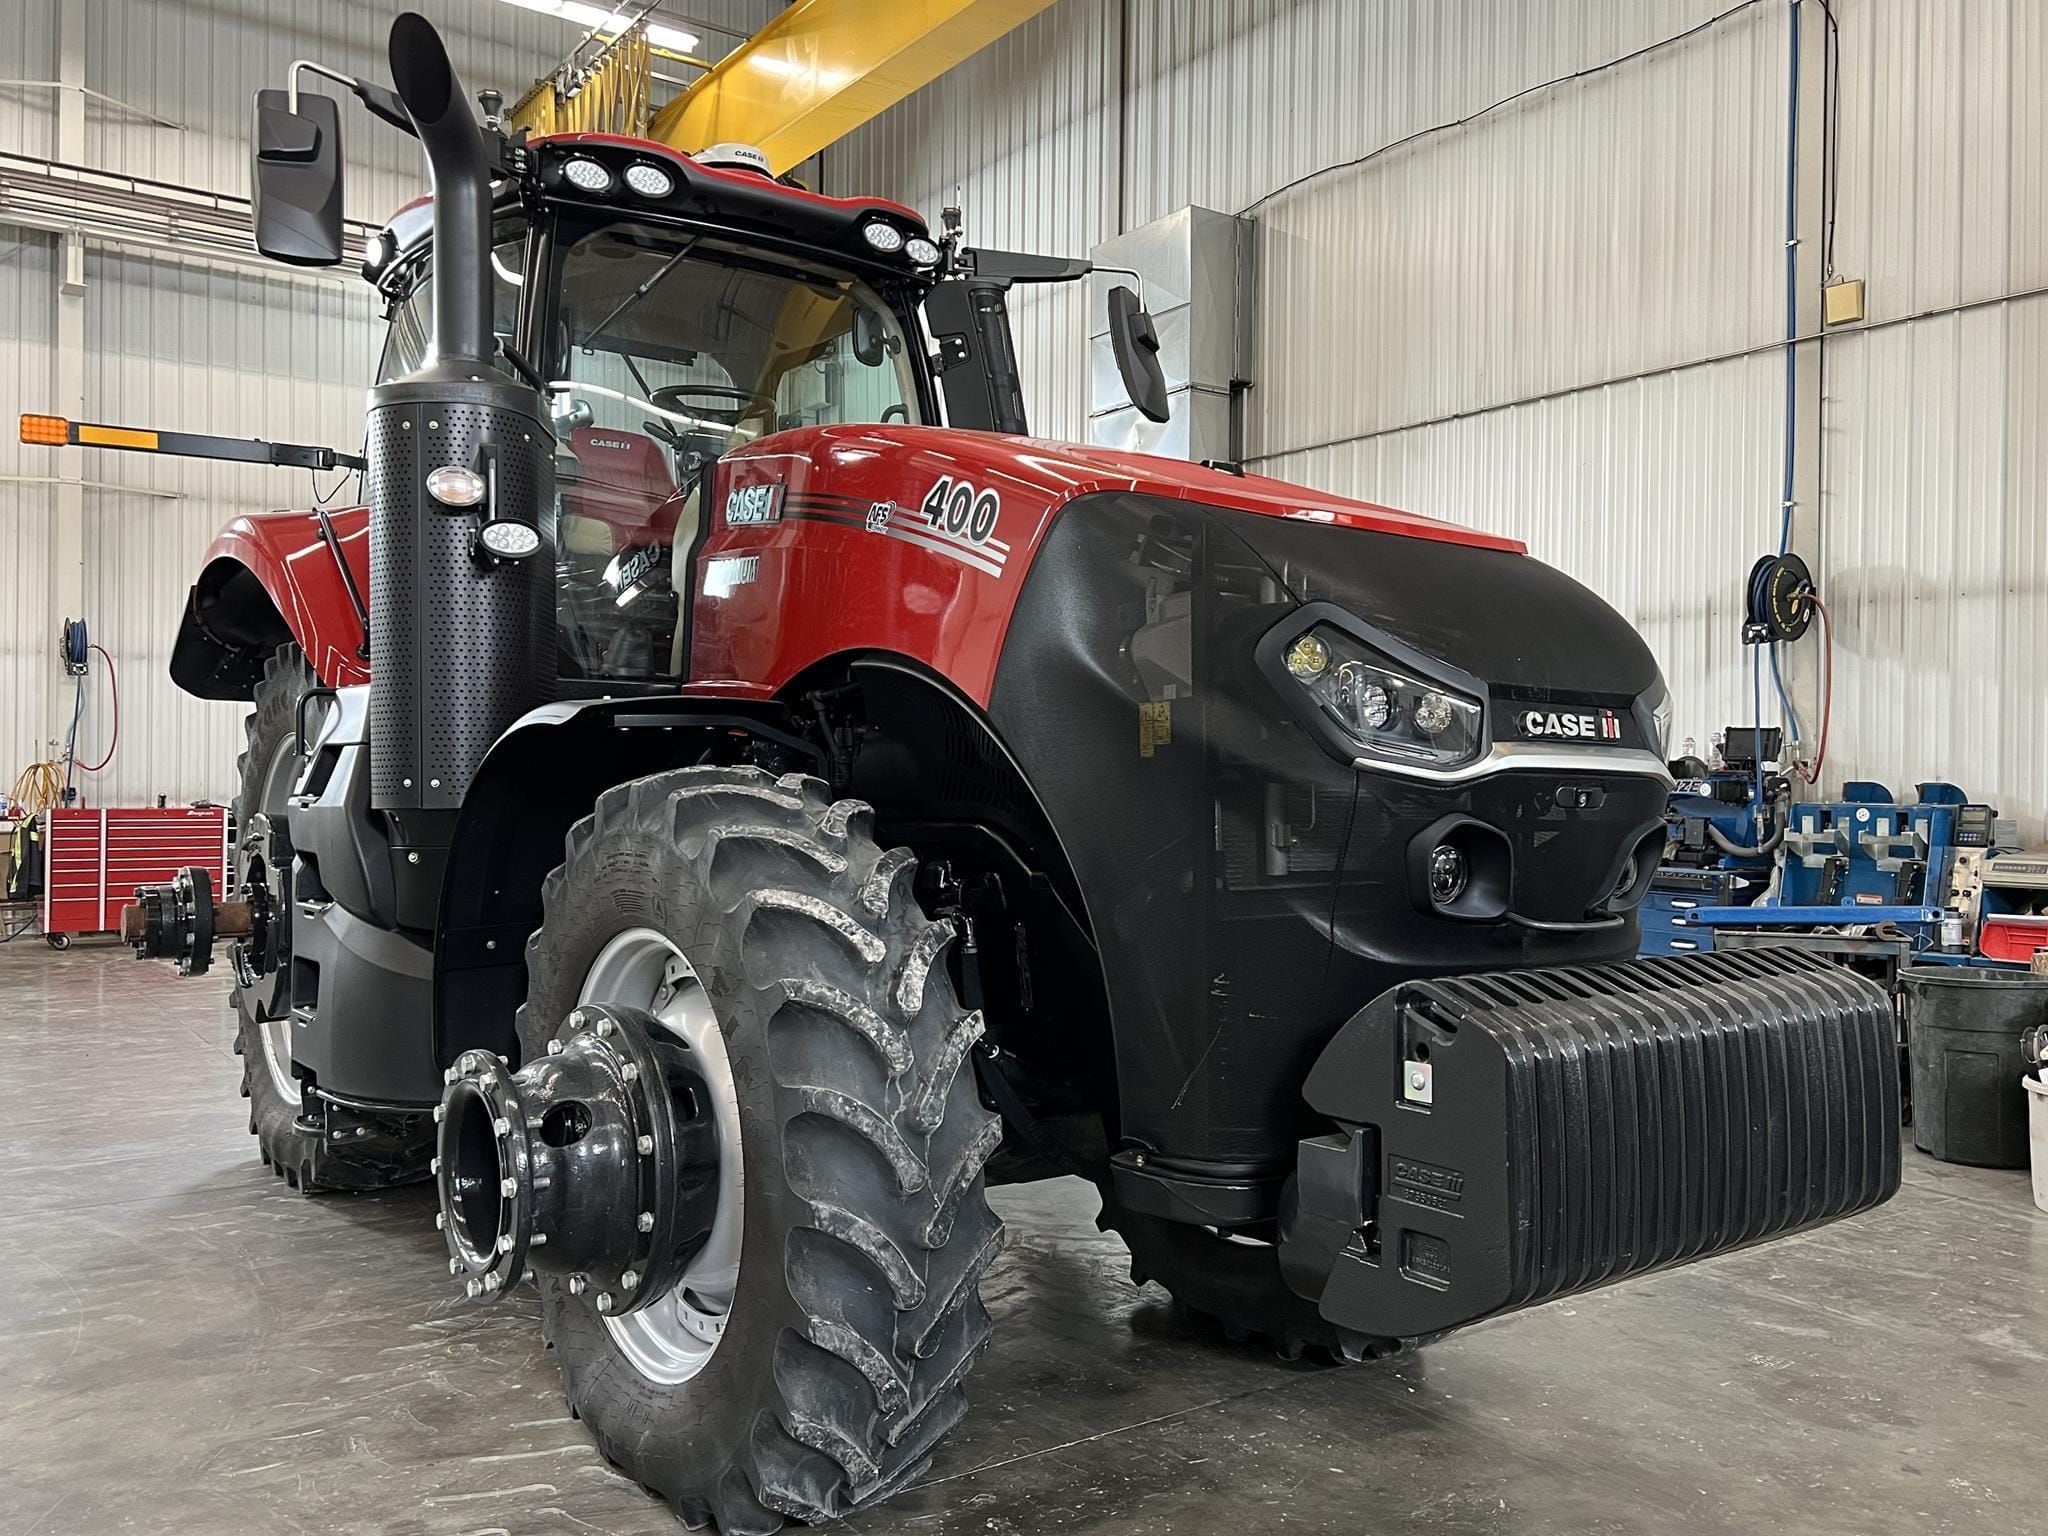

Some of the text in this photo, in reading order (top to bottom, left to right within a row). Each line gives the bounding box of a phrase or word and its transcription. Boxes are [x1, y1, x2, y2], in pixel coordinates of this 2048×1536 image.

[734, 150, 757, 160] CASE
[590, 438, 620, 449] CASE
[726, 485, 769, 523] CASE
[867, 502, 891, 524] AFS
[920, 474, 1000, 546] 400
[1525, 711, 1596, 737] CASE
[1396, 1162, 1444, 1188] CASE
